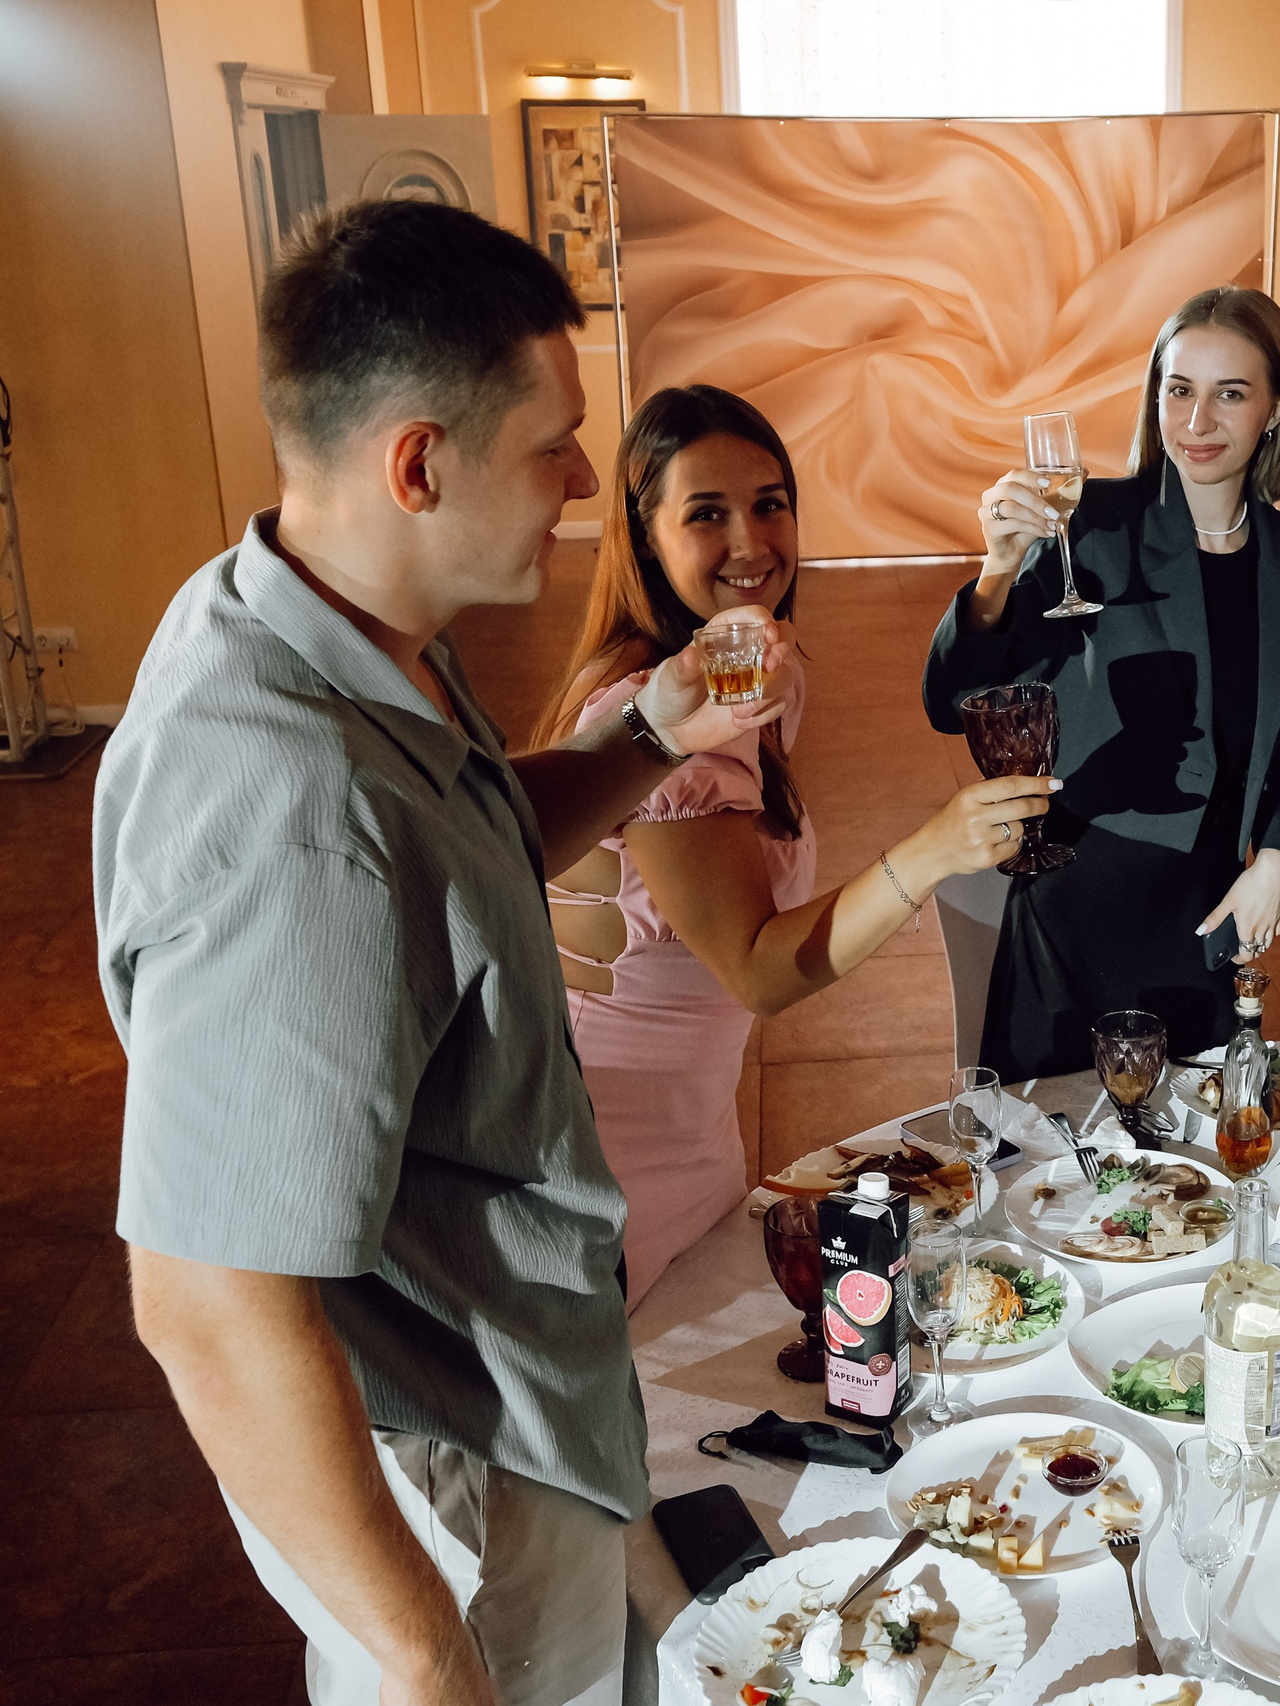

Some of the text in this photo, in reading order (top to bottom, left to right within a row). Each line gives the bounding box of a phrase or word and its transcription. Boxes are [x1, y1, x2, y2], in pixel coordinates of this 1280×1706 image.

[821, 1246, 858, 1265] PREMIUM
[830, 1258, 848, 1267] CLUB
[826, 1366, 880, 1387] GRAPEFRUIT
